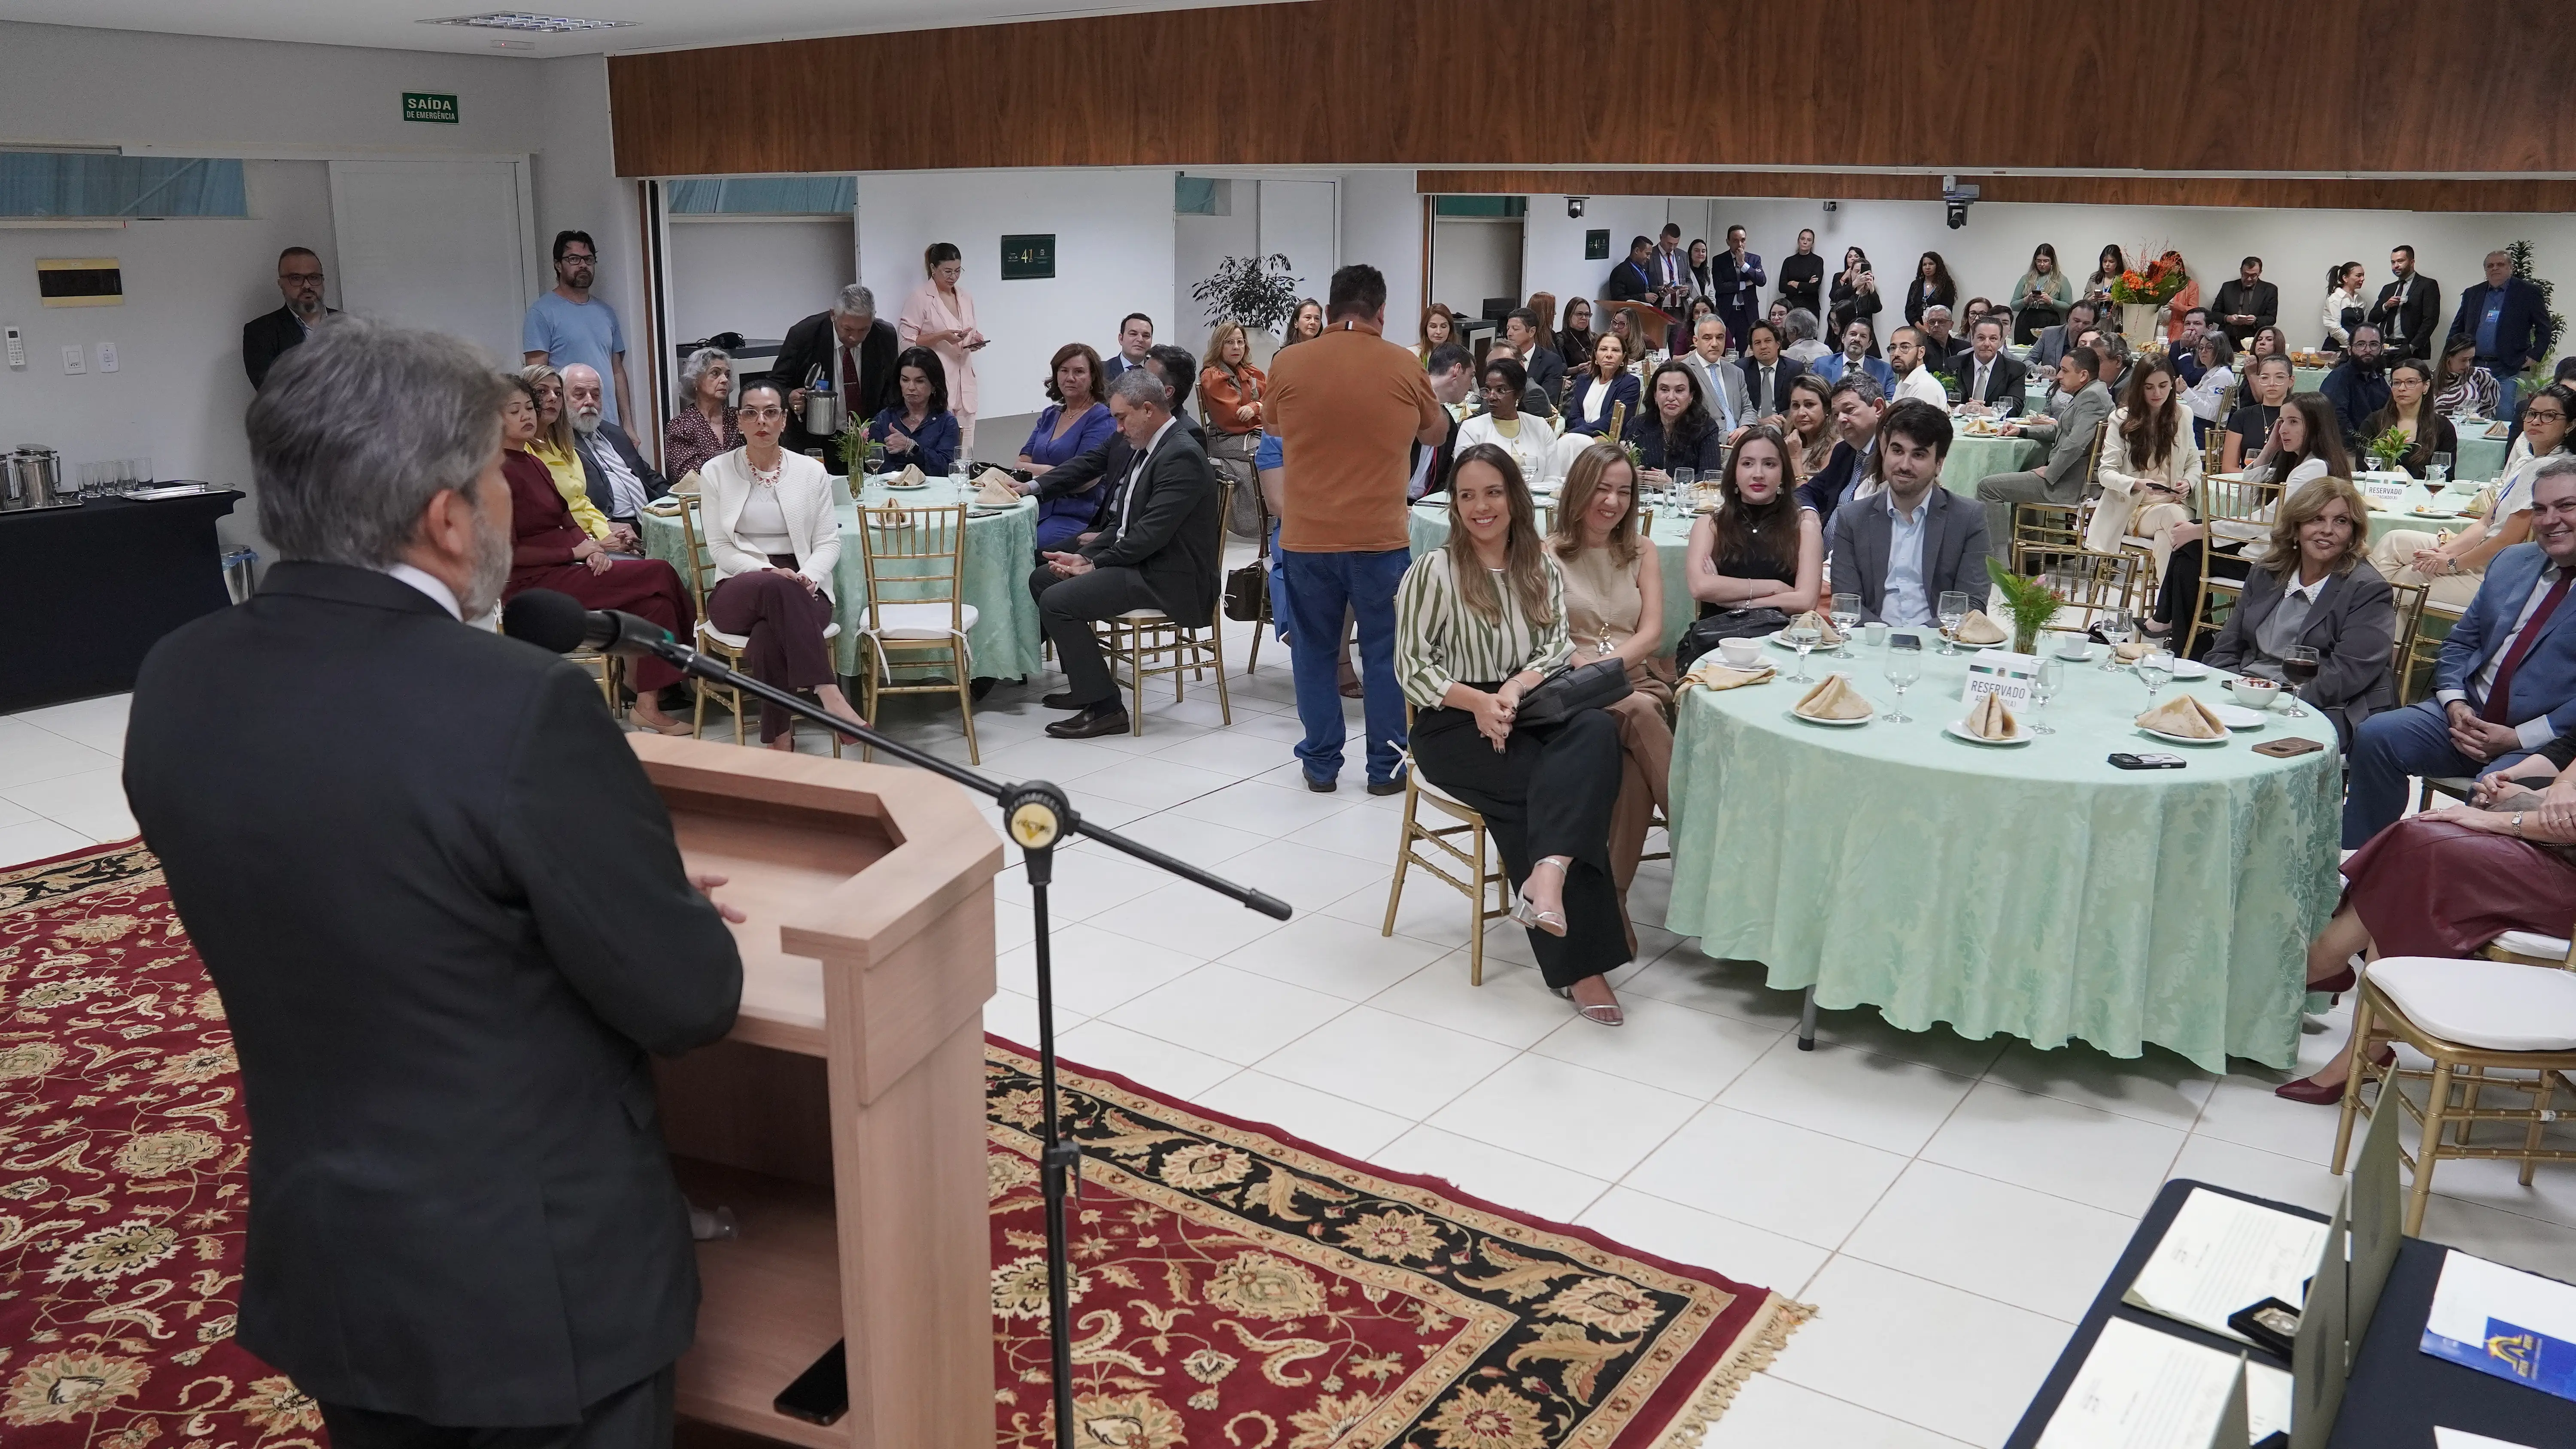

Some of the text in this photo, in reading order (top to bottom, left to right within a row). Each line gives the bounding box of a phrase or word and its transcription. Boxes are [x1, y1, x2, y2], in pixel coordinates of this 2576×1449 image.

[408, 97, 451, 110] SAÍDA
[416, 110, 455, 120] EMERGÊNCIA
[1021, 249, 1034, 264] 41
[2369, 487, 2402, 495] RESERVADO
[1971, 680, 2026, 699] RESERVADO
